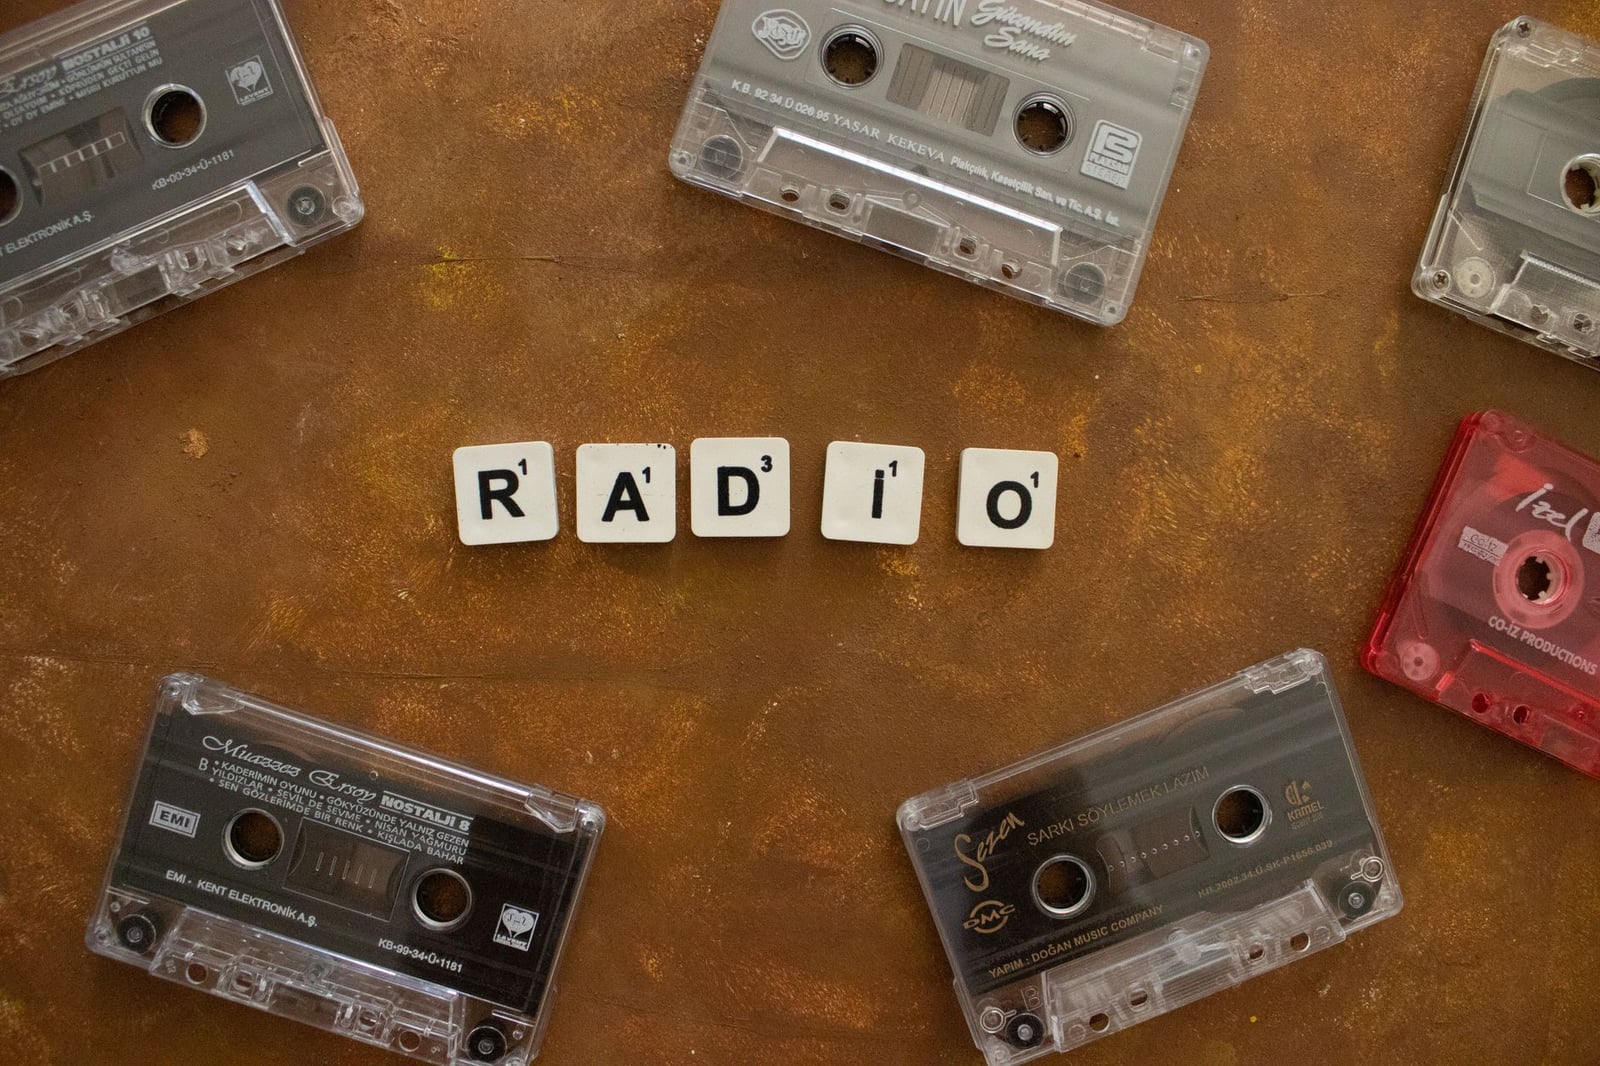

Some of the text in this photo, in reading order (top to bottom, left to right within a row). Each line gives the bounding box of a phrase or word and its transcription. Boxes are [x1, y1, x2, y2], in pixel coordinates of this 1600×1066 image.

[984, 26, 1050, 61] Sana
[831, 113, 880, 139] YAŞAR
[886, 133, 946, 163] KEKEVA
[518, 458, 528, 475] 1
[642, 466, 651, 483] 1
[761, 455, 773, 472] 3
[889, 460, 898, 477] 1
[1030, 471, 1039, 488] 1
[1519, 630, 1599, 676] PRODUCTIONS
[197, 757, 209, 772] B
[202, 735, 301, 776] Muazzez
[308, 769, 376, 804] Ersoy
[457, 819, 470, 832] 8
[159, 810, 190, 827] EMI
[210, 767, 264, 790] YILDIZLAR
[307, 798, 322, 810] DE
[325, 804, 361, 823] SEVME
[410, 832, 467, 856] YAĞMURU
[220, 761, 469, 847] KADERİMİN OYUNU GÖKYÜZÜNDE YALNIZ GEZEN
[1076, 785, 1160, 827] SÖYLEMEK
[1162, 765, 1209, 793] LAZIM
[217, 779, 238, 792] SEN
[334, 816, 364, 833] RENK
[376, 830, 423, 851] KIŞLADA
[426, 846, 464, 864] BAHAR
[954, 812, 1025, 892] Sezen
[165, 869, 185, 884] EMI
[196, 879, 226, 896] KENT
[228, 889, 297, 920] ELEKTRONİK
[962, 903, 1016, 930] DMC
[988, 904, 1164, 979] YAPIM DOĞAN MUSIC COMPANY
